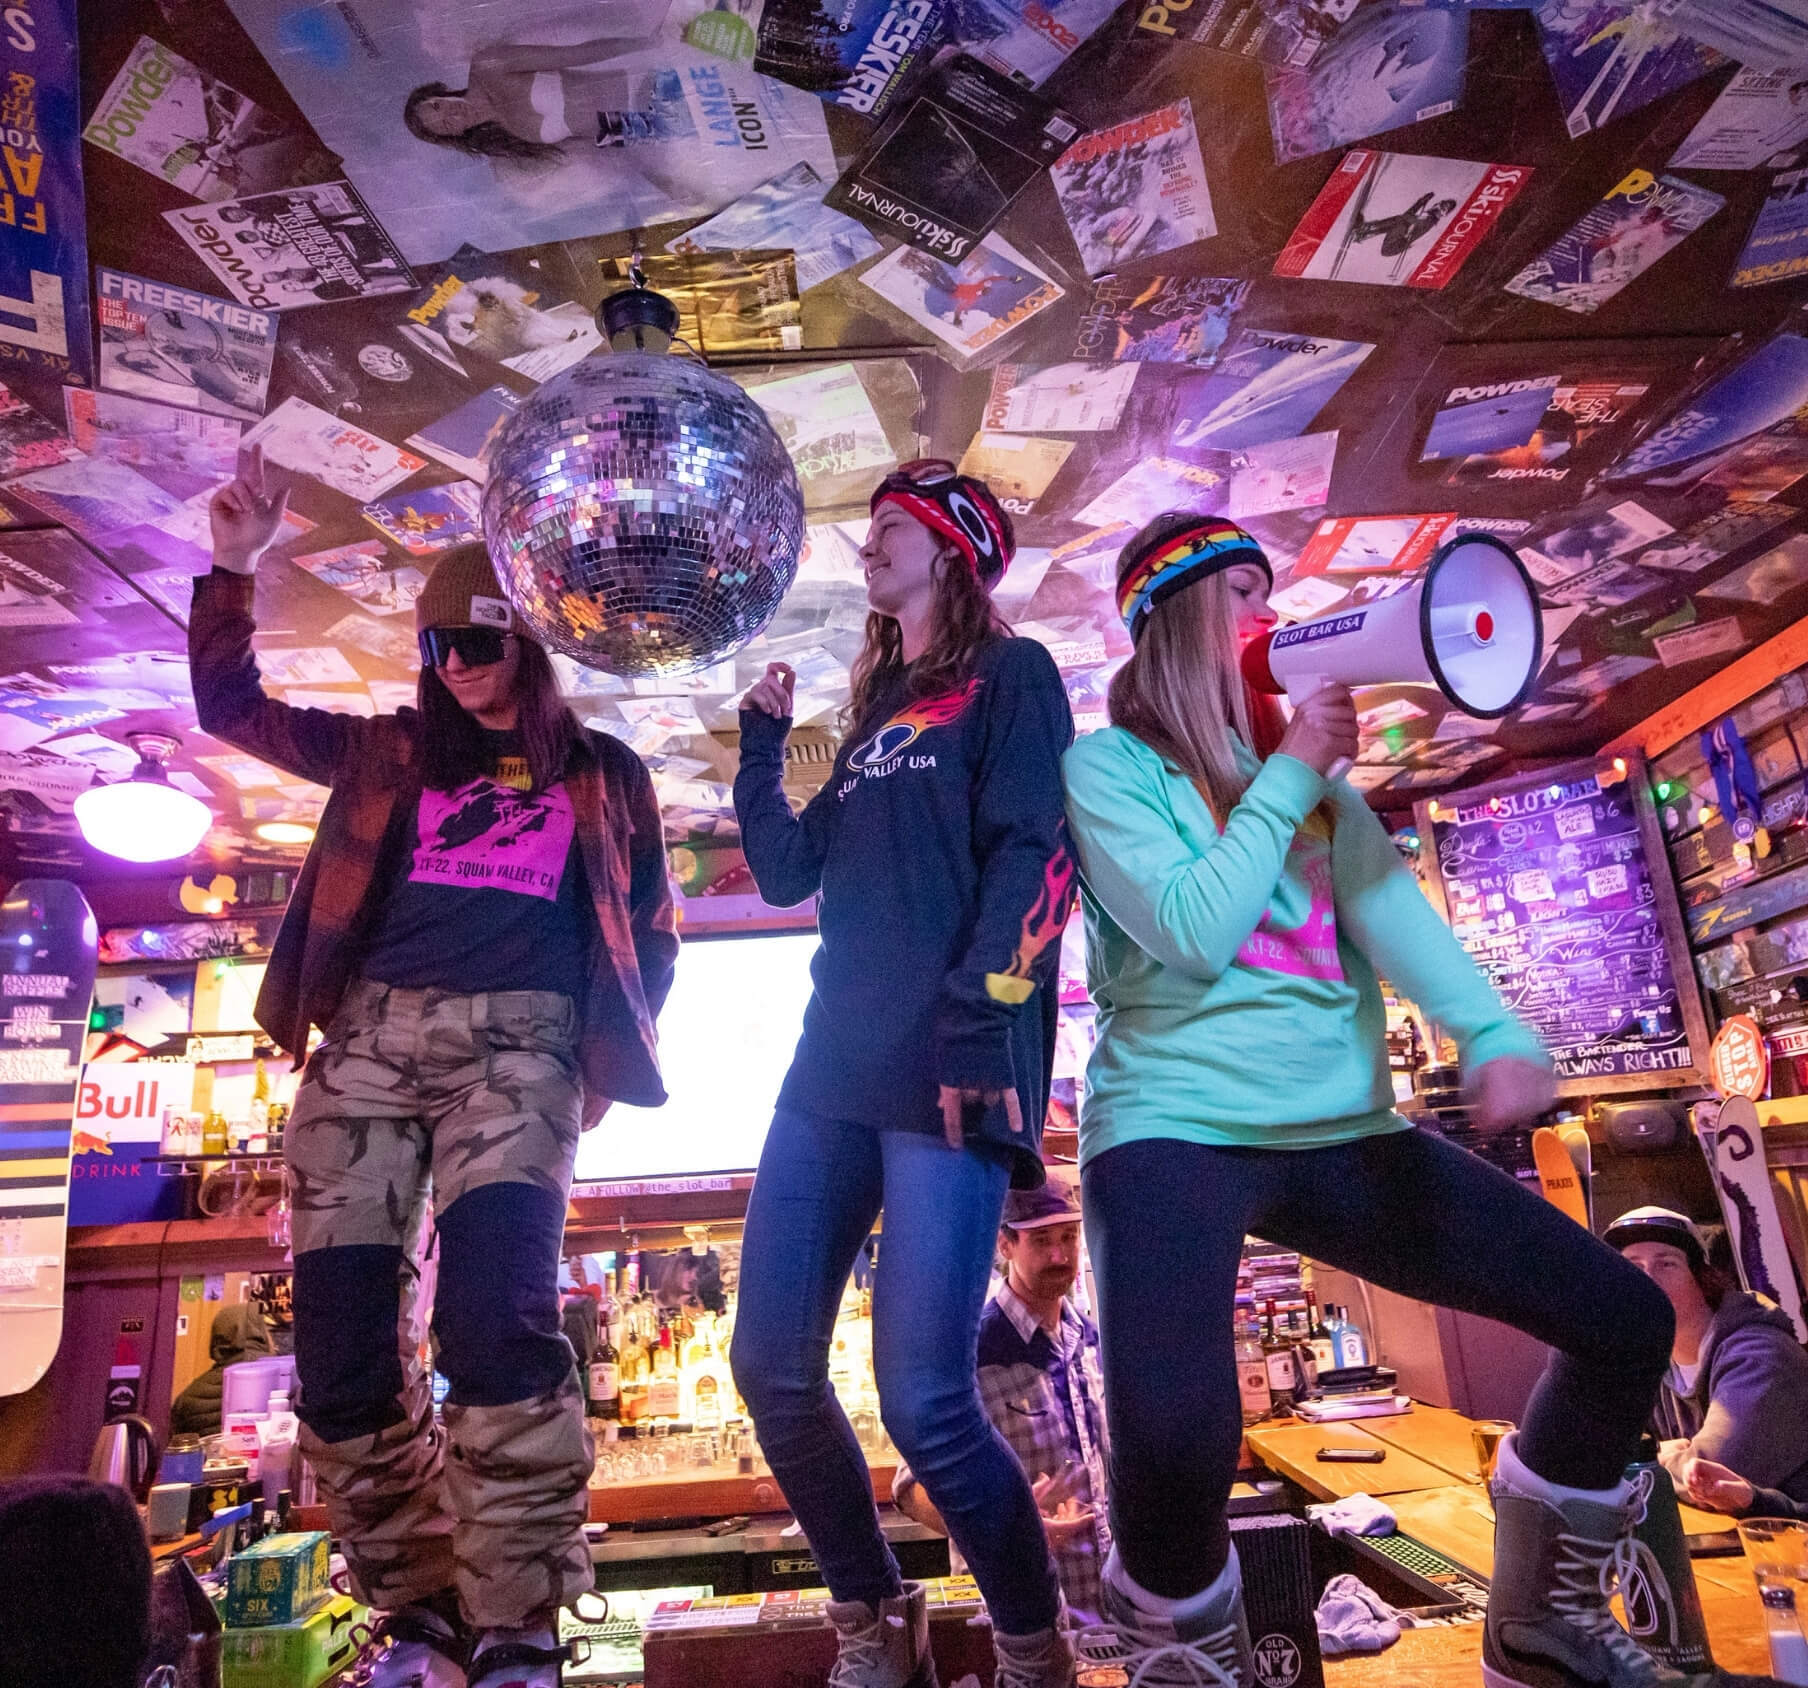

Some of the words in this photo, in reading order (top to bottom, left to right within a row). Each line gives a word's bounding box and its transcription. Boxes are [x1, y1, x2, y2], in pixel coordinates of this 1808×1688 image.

[897, 51, 915, 74] TOM
[689, 65, 741, 146] LANGE
[872, 72, 902, 116] WALLISCH
[732, 102, 768, 150] ICON
[180, 213, 280, 310] Powder
[102, 271, 270, 335] FREESKIER
[102, 299, 122, 309] THE
[408, 274, 463, 325] Powder
[103, 317, 136, 331] ISSUE
[1446, 374, 1563, 405] POWDER
[1575, 409, 1620, 423] THE
[1488, 468, 1569, 481] Powder
[1276, 629, 1306, 647] SLOT
[1308, 621, 1335, 638] BAR
[1336, 615, 1361, 632] USA
[864, 755, 904, 779] VALLEY
[908, 756, 936, 769] USA
[1496, 789, 1557, 818] SLOT
[1561, 778, 1598, 800] BAR
[456, 861, 494, 879] SQUAW
[540, 872, 554, 888] CA
[1552, 1049, 1573, 1061] THE
[1577, 1042, 1648, 1058] BARTENDER
[1729, 1031, 1753, 1091] STOP
[1552, 1057, 1615, 1076] ALWAYS
[77, 1081, 159, 1118] Bull
[72, 1165, 142, 1179] DRINK
[247, 1599, 268, 1612] SIX
[1266, 1640, 1284, 1650] OLD
